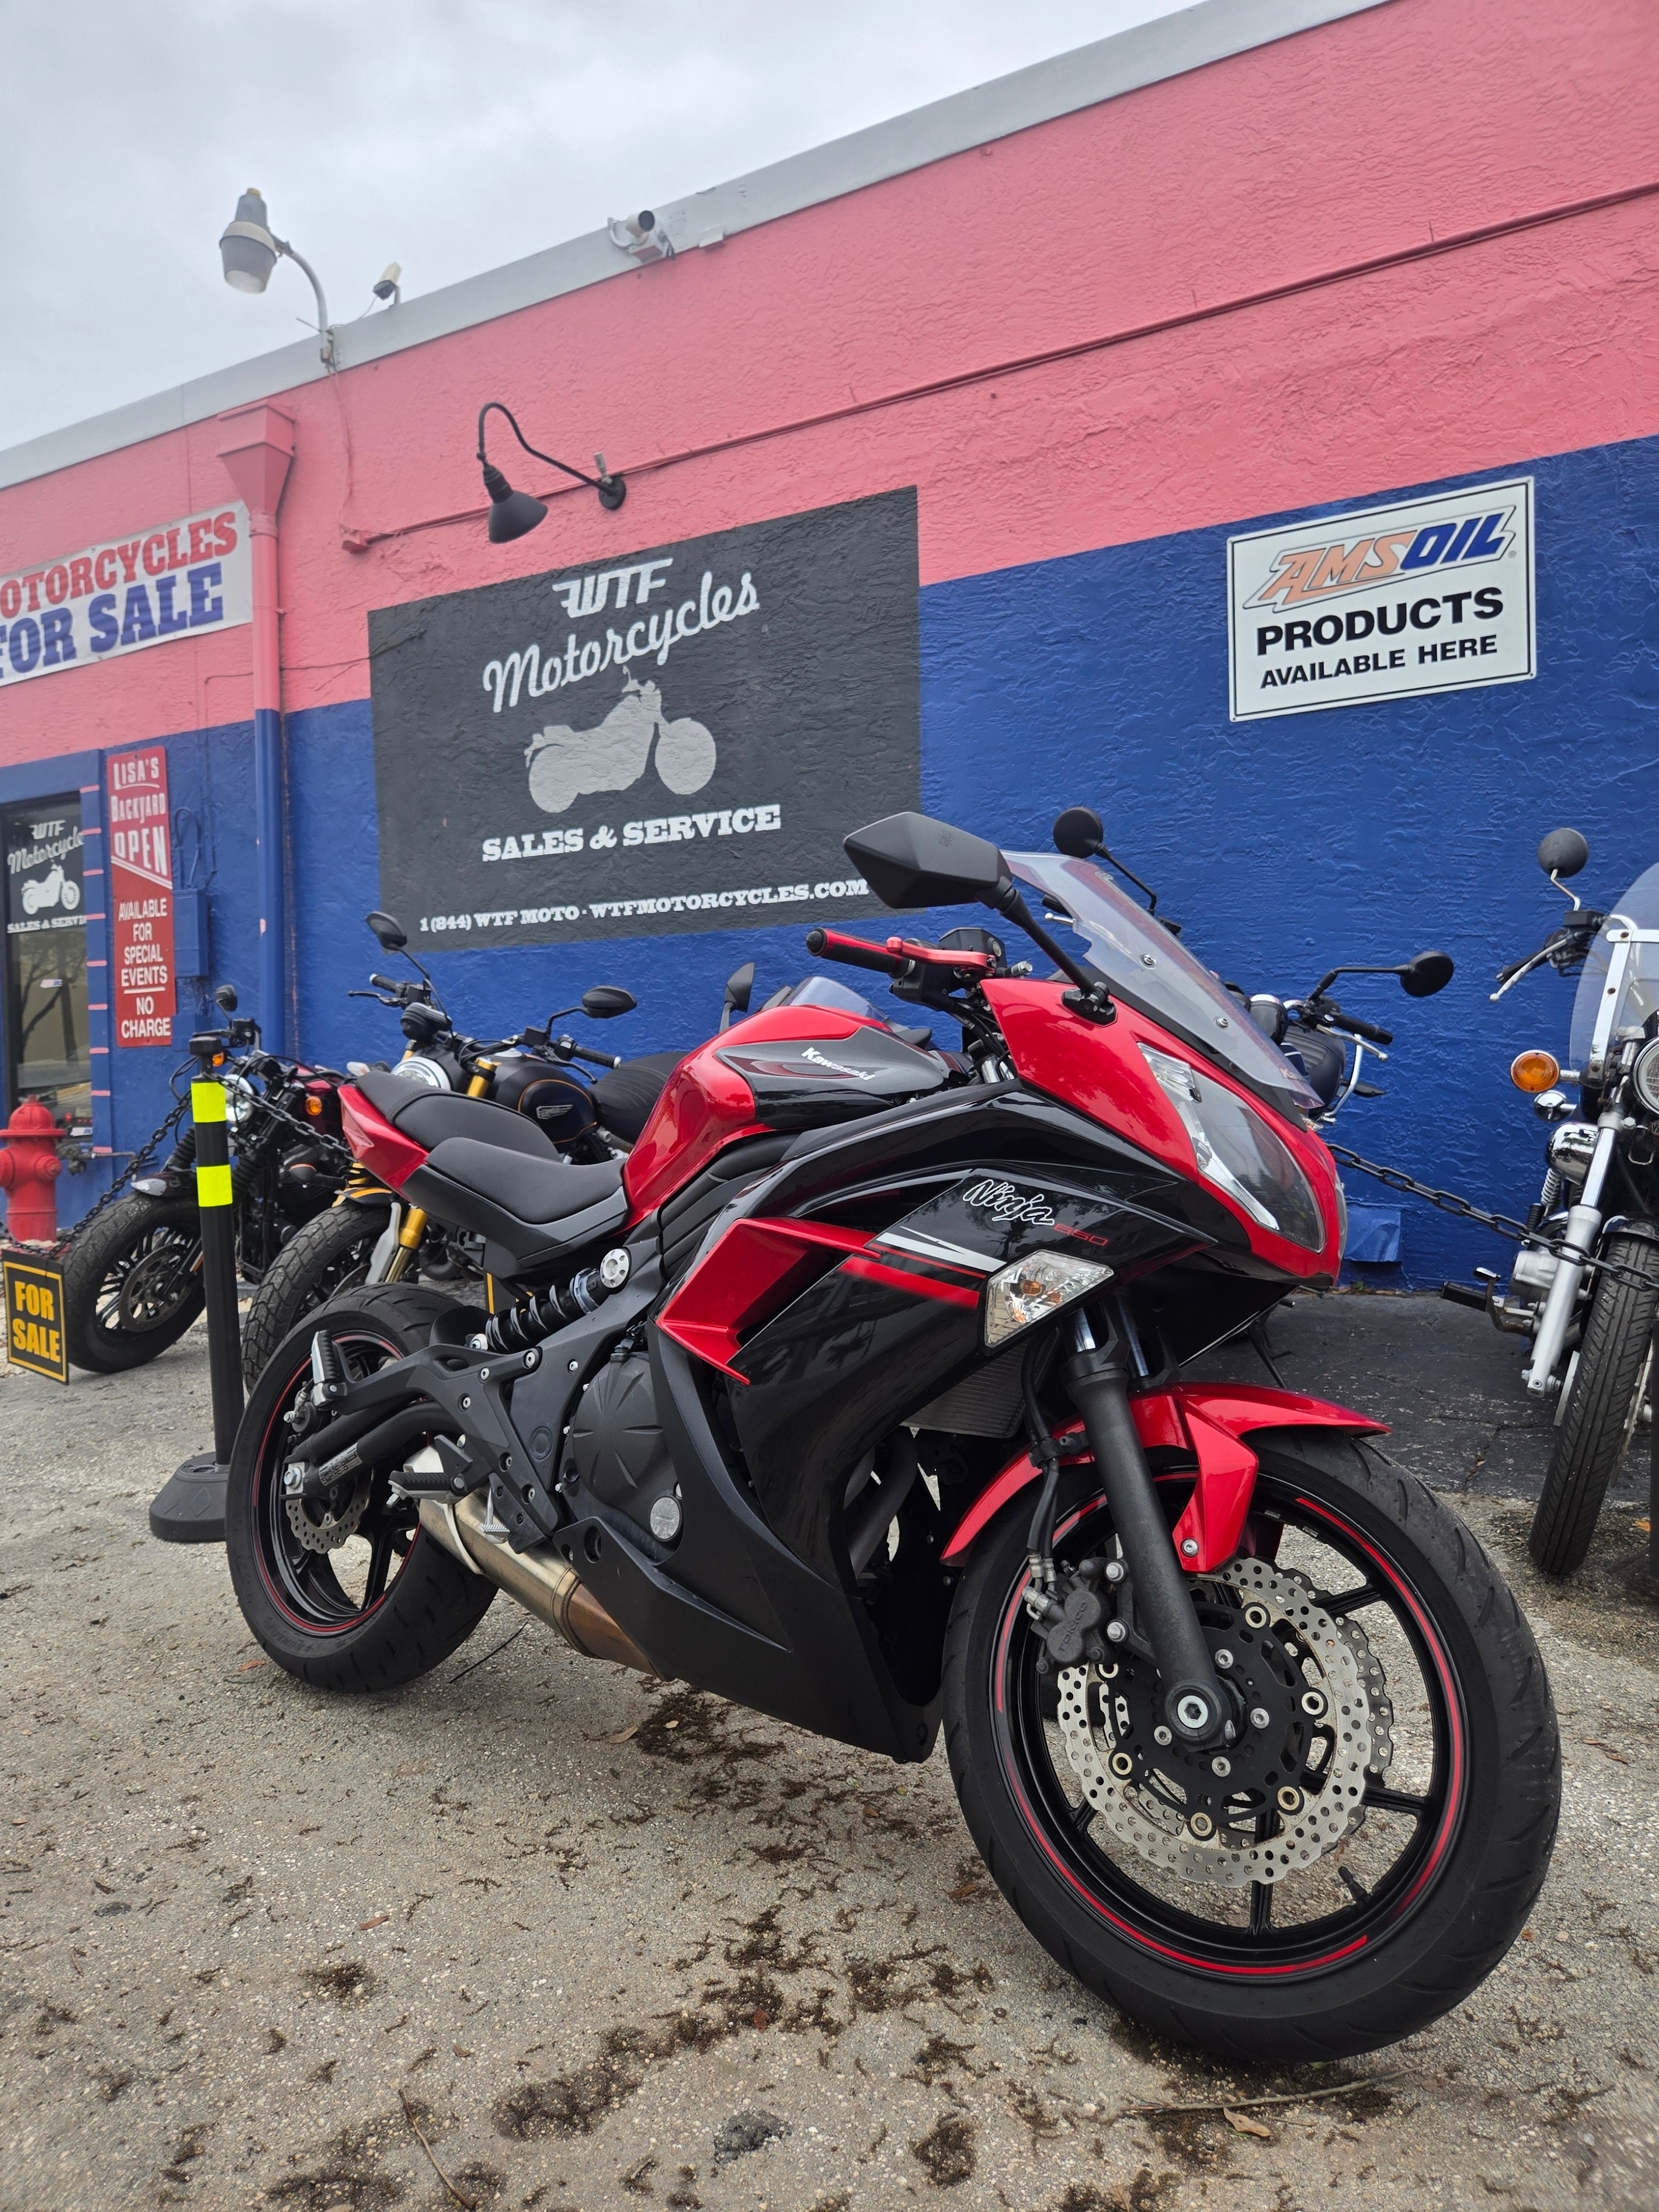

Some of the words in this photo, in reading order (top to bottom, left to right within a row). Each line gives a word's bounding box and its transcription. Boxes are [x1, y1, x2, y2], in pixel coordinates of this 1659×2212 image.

[0, 512, 237, 619] OTORCYCLES
[1257, 512, 1506, 606] AMSOIL
[88, 562, 223, 653] SALE
[552, 558, 674, 618] WTF
[482, 571, 760, 712] Motorcycles
[1257, 587, 1504, 656] PRODUCTS
[1260, 649, 1406, 689] AVAILABLE
[1418, 634, 1498, 664] HERE
[113, 757, 160, 790] LISA'S
[7, 826, 84, 874] Motorcycle
[29, 820, 66, 839] WTF
[114, 826, 168, 876] OPEN
[482, 827, 583, 862] SALES
[589, 826, 617, 849] &
[623, 804, 781, 847] SERVICE
[118, 898, 168, 922] AVAILABLE
[420, 917, 429, 931] 1
[431, 914, 472, 932] (844)
[473, 911, 518, 927] WTF
[520, 906, 580, 924] MOTO
[589, 879, 869, 919] WTFMOTORCYCLES.COM
[124, 943, 163, 965] SPECIAL
[133, 922, 153, 942] FOR
[121, 965, 168, 987] EVENTS
[121, 1018, 171, 1039] CHARGE
[136, 996, 154, 1015] NO
[801, 1047, 876, 1081] Kawasaki
[963, 1180, 1055, 1225] Ninja
[1053, 1223, 1109, 1246] 650
[14, 1281, 54, 1321] FOR
[12, 1318, 61, 1363] SALE
